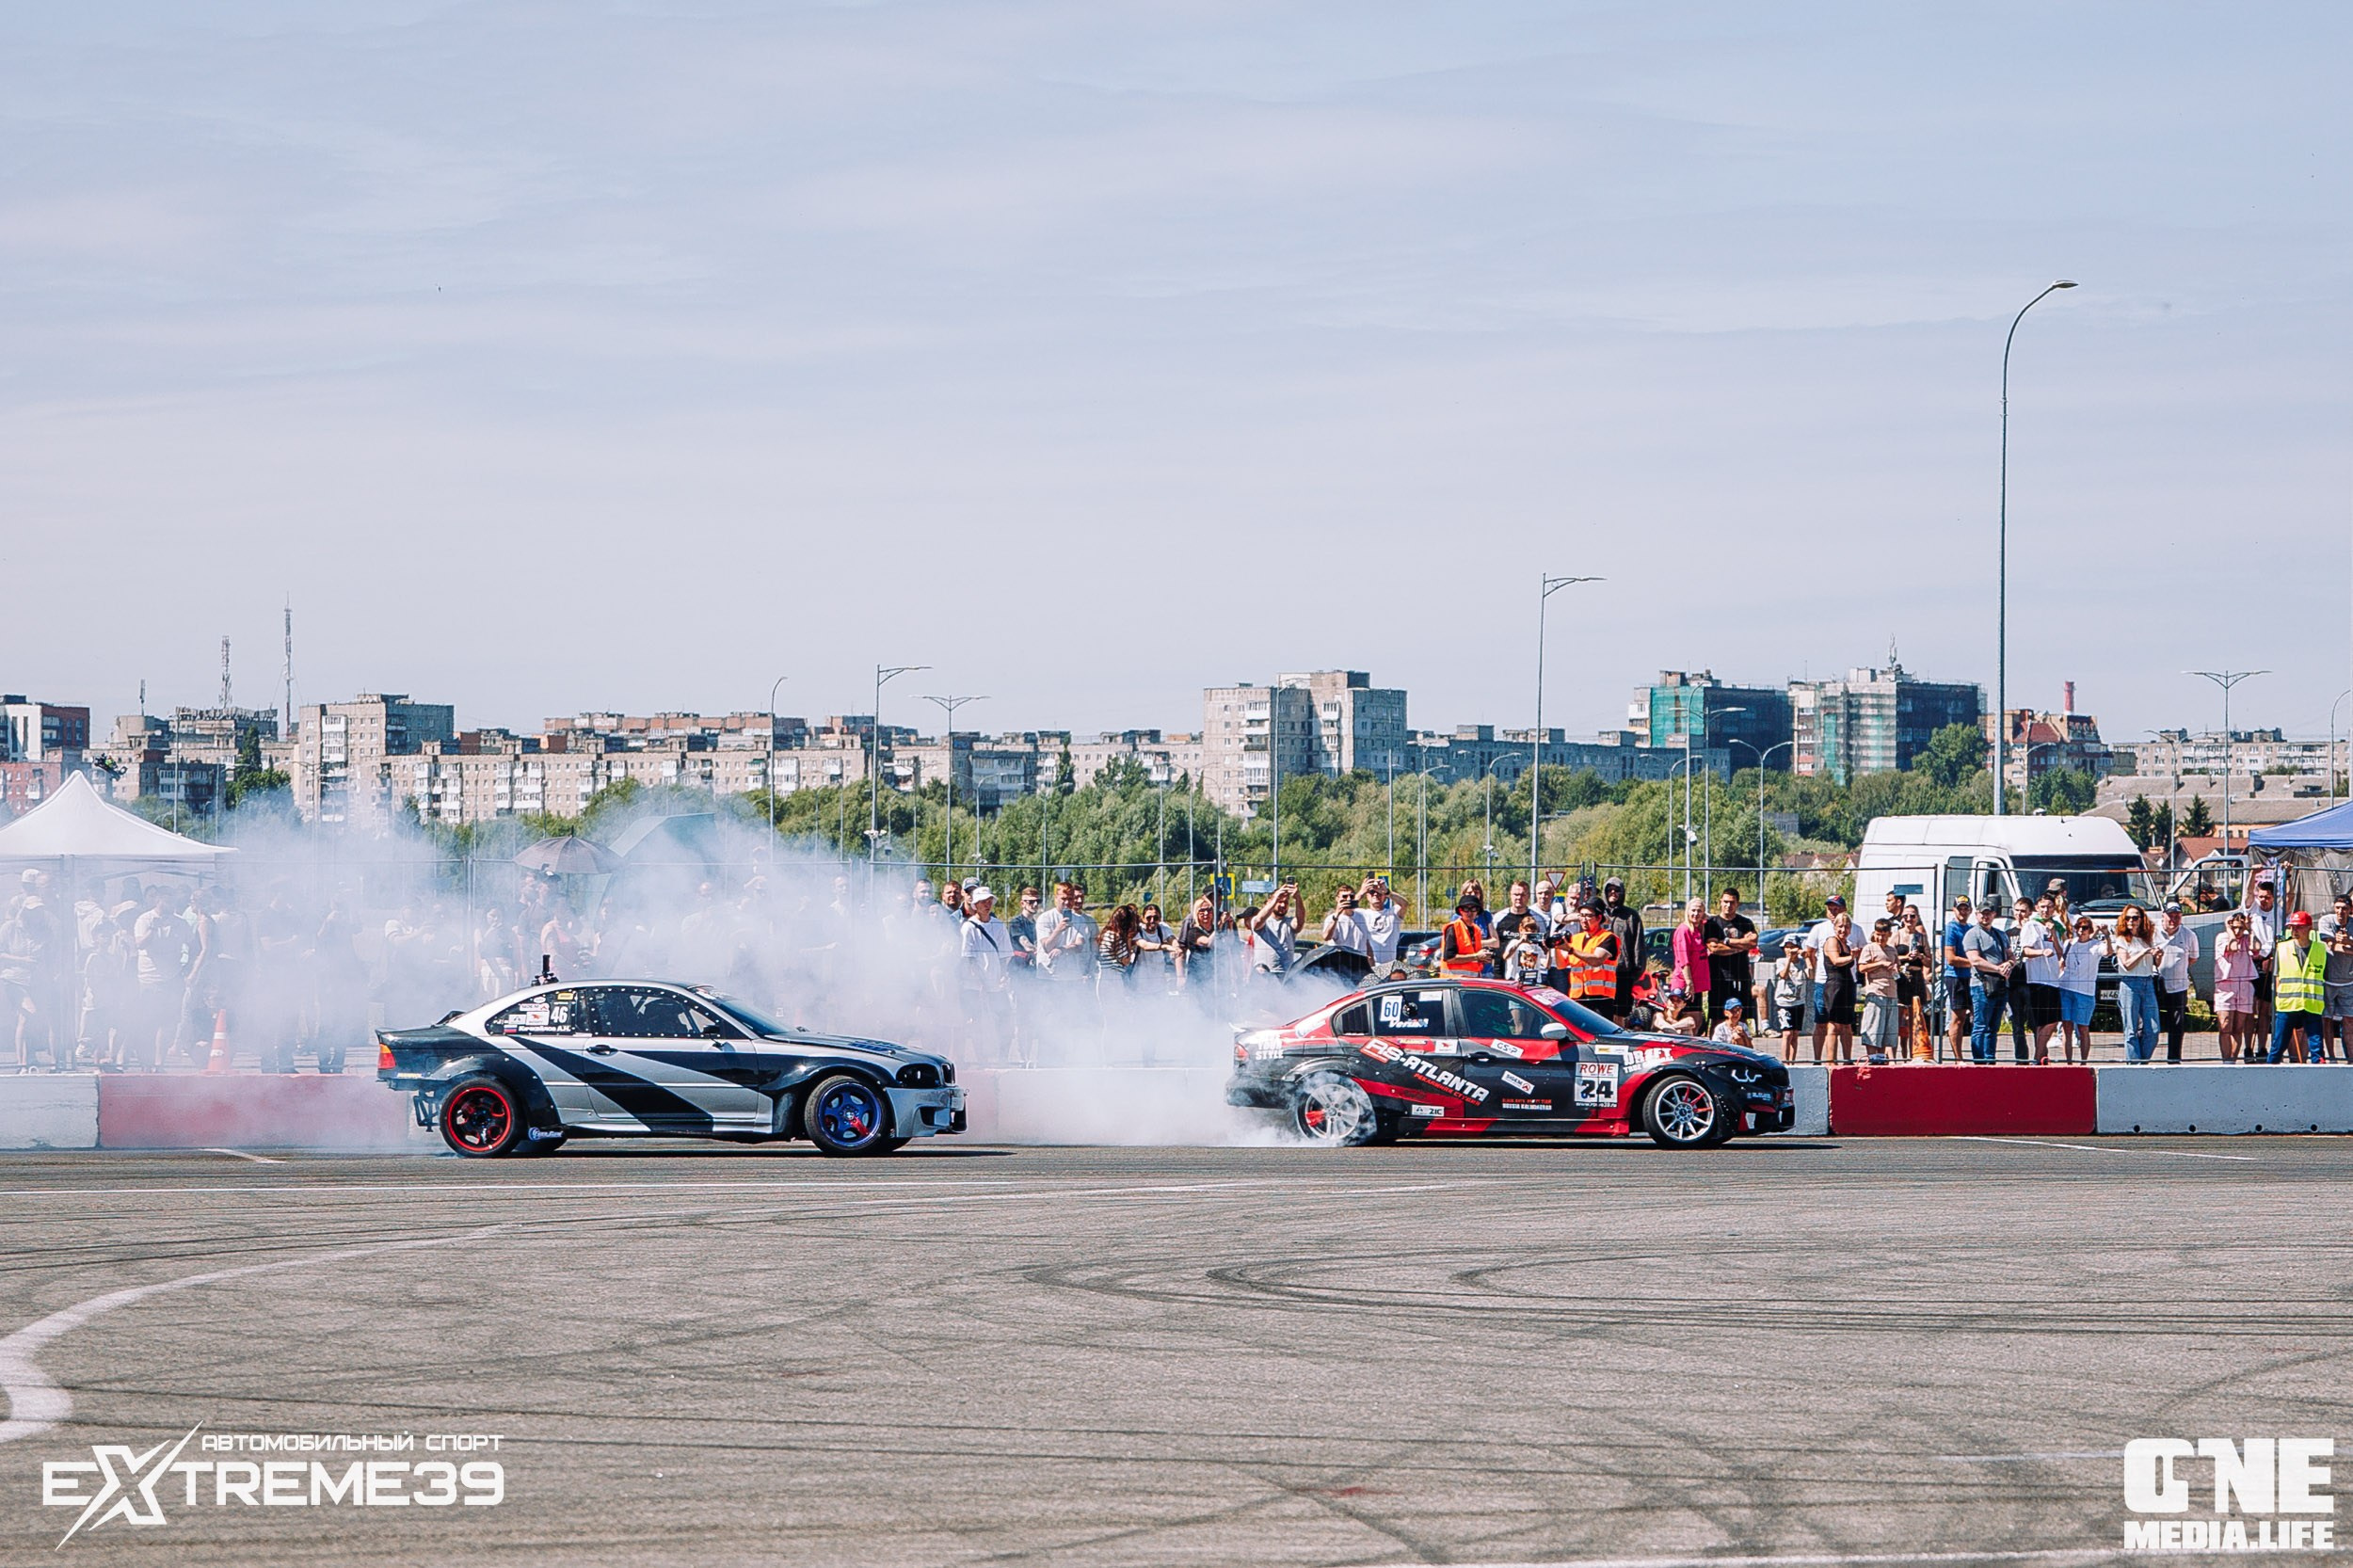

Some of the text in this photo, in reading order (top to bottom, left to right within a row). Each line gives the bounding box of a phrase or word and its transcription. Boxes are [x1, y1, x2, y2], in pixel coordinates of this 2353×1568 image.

[1503, 930, 1520, 938] Kap
[551, 1006, 568, 1024] 46
[1384, 1001, 1400, 1017] 60
[1256, 1048, 1285, 1060] STYLE
[1579, 1064, 1614, 1074] ROWE
[1580, 1080, 1614, 1099] 24
